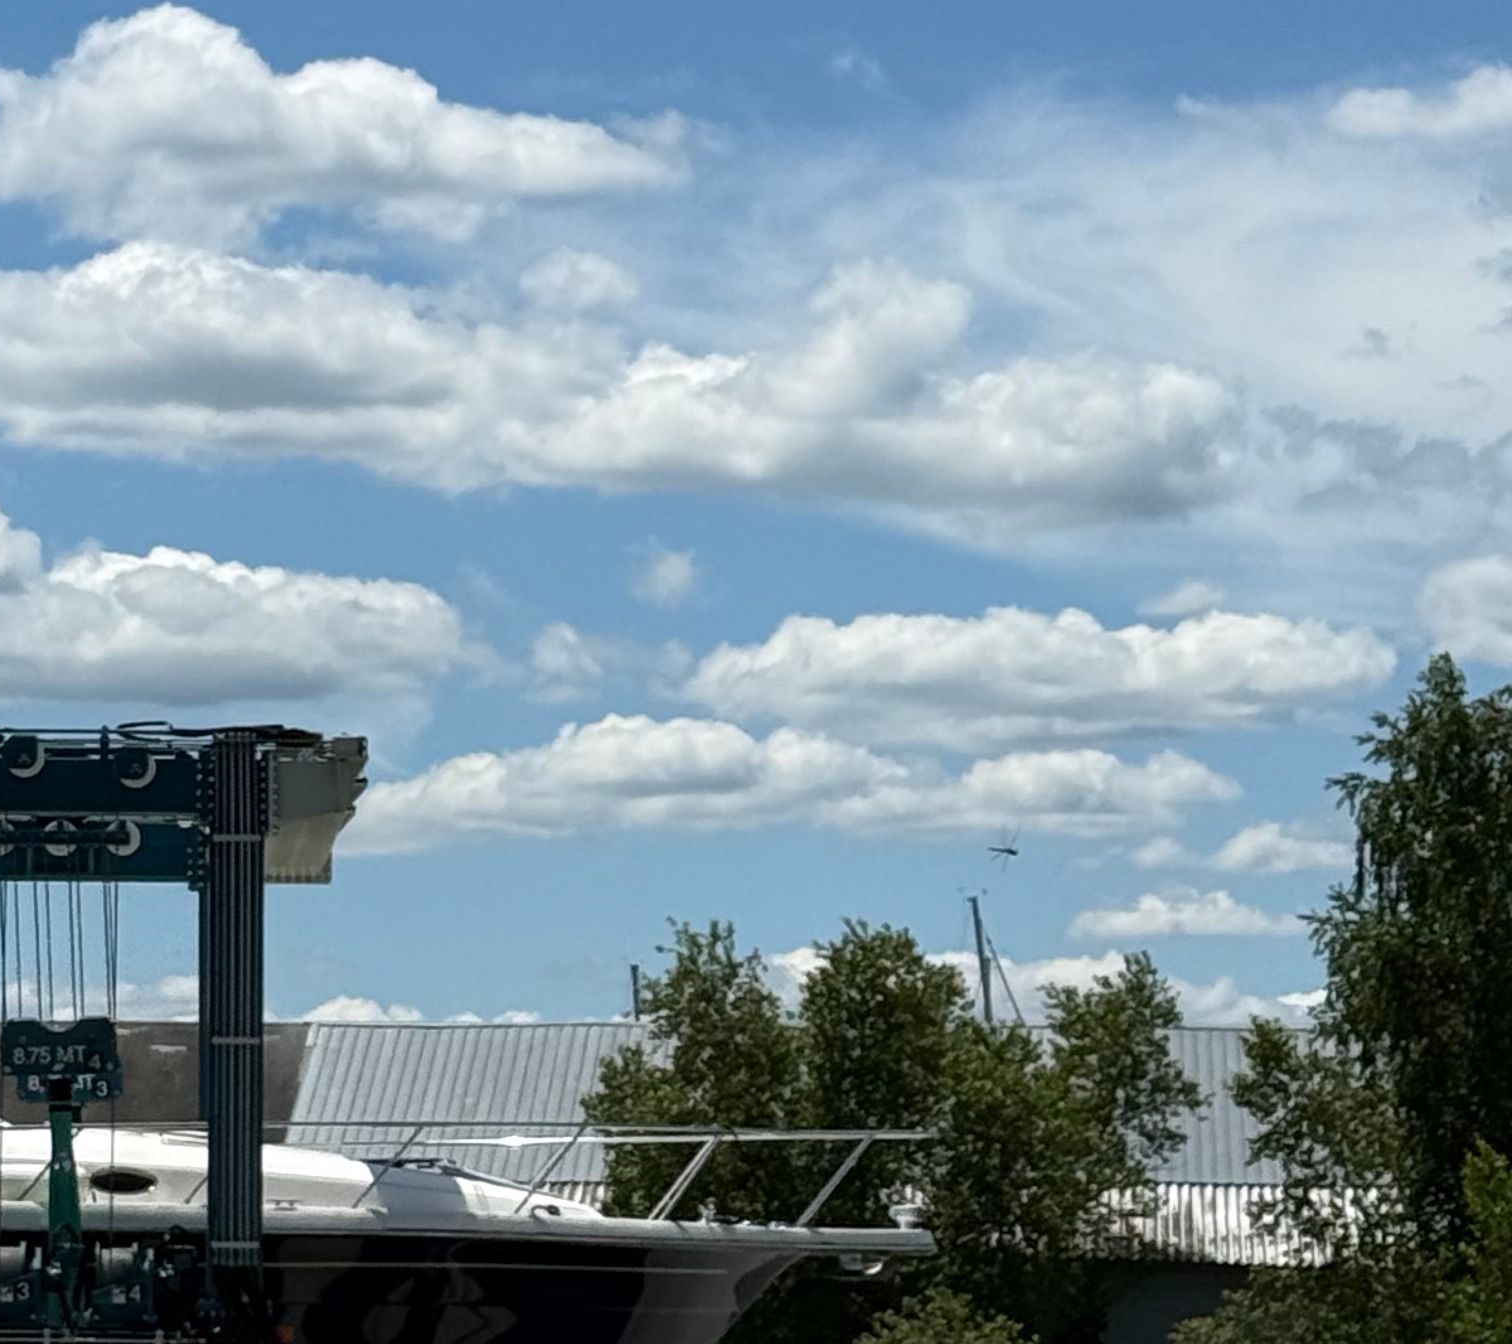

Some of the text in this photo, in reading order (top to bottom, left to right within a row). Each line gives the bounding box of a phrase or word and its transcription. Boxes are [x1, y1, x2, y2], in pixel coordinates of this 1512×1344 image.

[13, 1045, 52, 1065] 8.75
[96, 1081, 108, 1097] 3
[16, 1281, 30, 1300] 3
[127, 1284, 141, 1302] 4
